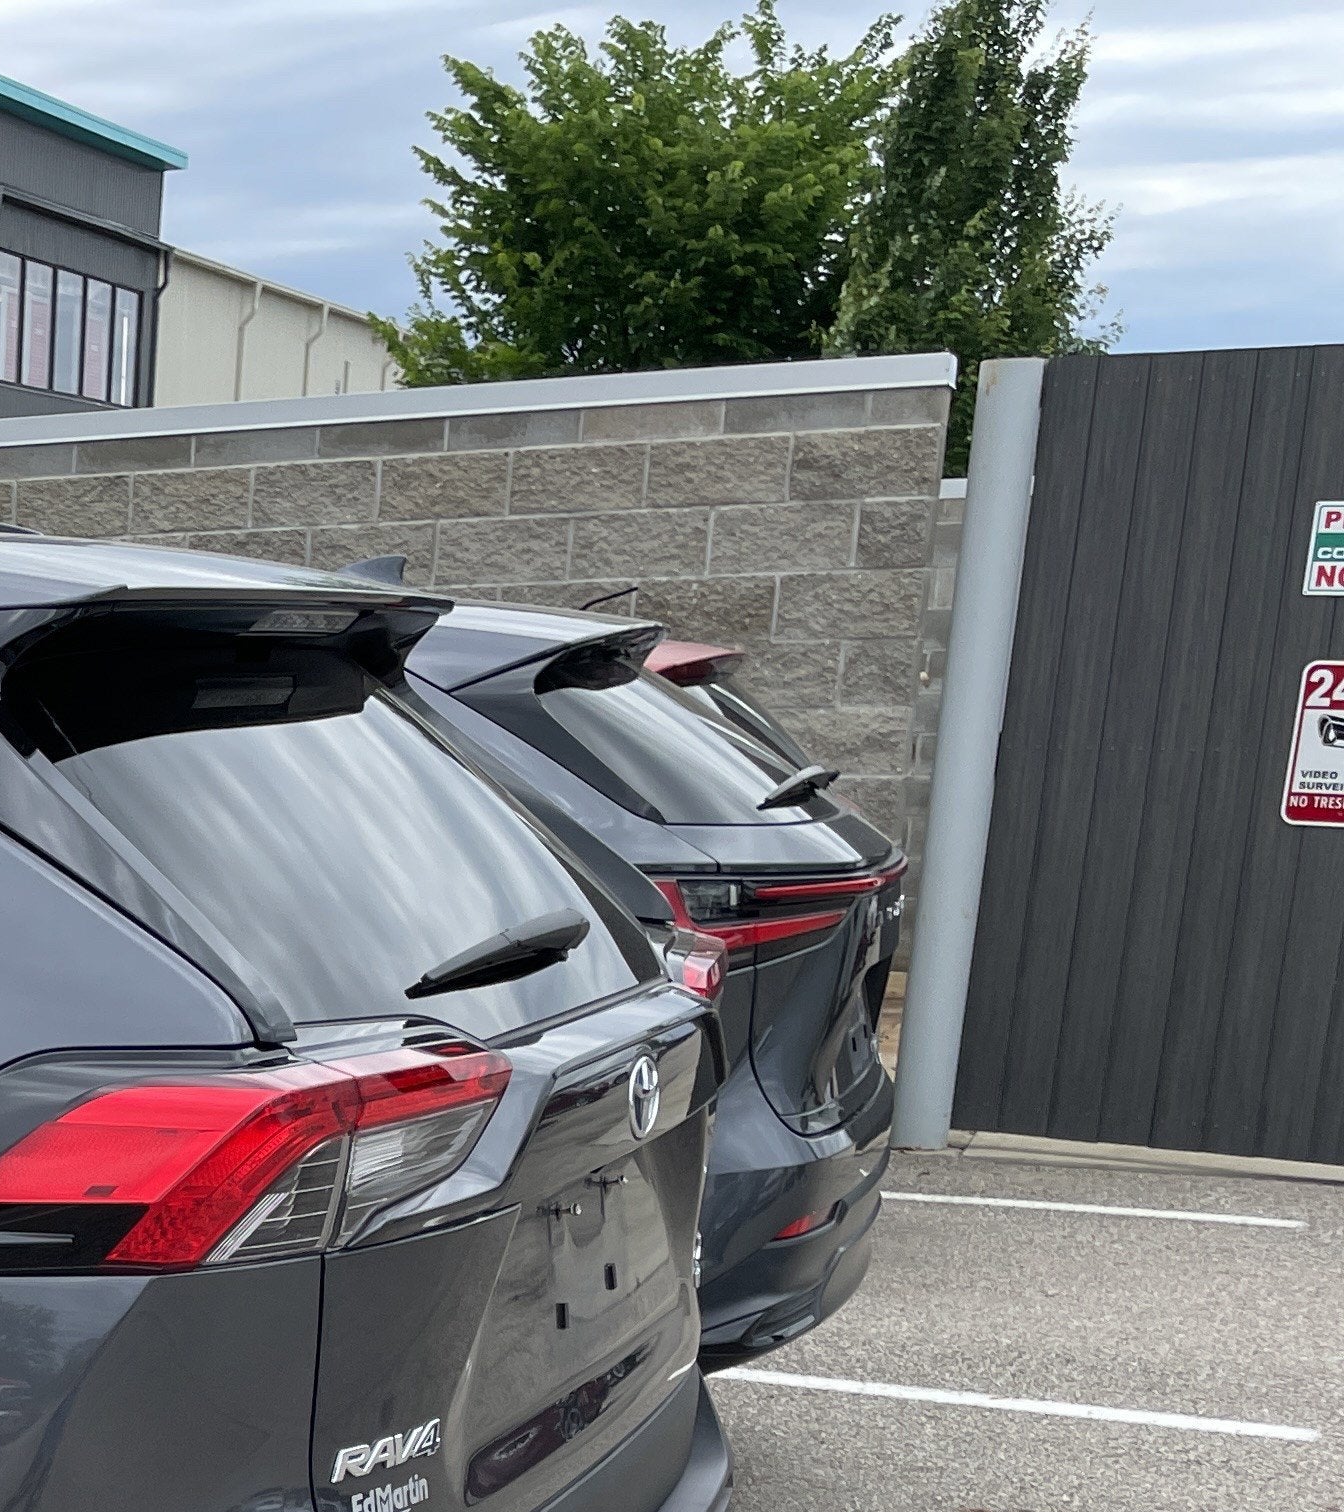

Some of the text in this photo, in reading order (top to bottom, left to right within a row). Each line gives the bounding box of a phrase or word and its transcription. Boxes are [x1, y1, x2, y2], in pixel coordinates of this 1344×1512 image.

[1324, 511, 1344, 529] P
[1301, 770, 1338, 780] VIDEO
[1289, 795, 1344, 810] NO TRES
[330, 1417, 441, 1484] RAV4
